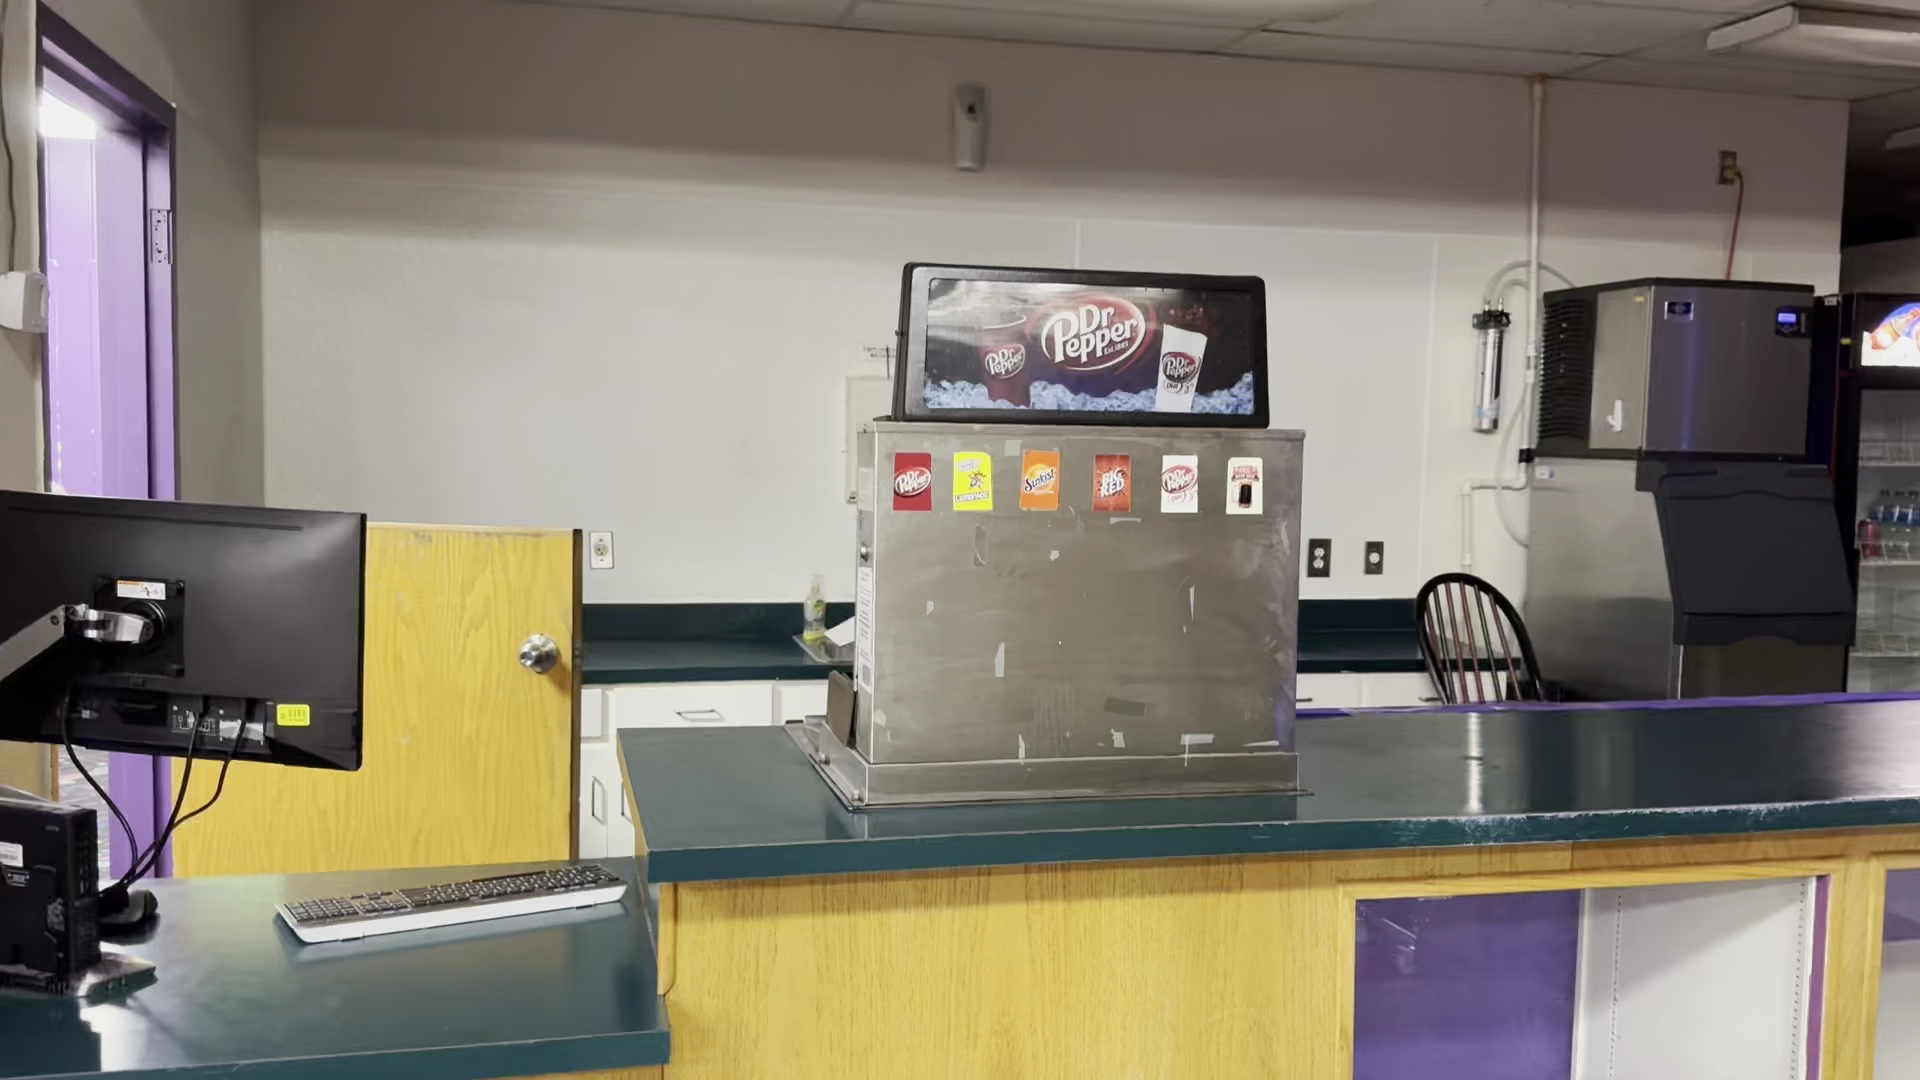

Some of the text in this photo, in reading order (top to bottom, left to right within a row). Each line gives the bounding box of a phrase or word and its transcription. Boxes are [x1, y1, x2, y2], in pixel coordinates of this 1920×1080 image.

[1042, 304, 1138, 364] Dr Pepper
[985, 348, 1022, 375] Dr Pepper
[896, 473, 929, 493] Pepper
[1024, 468, 1055, 492] Sunkist
[1102, 467, 1124, 484] BIG
[1101, 479, 1125, 498] RED
